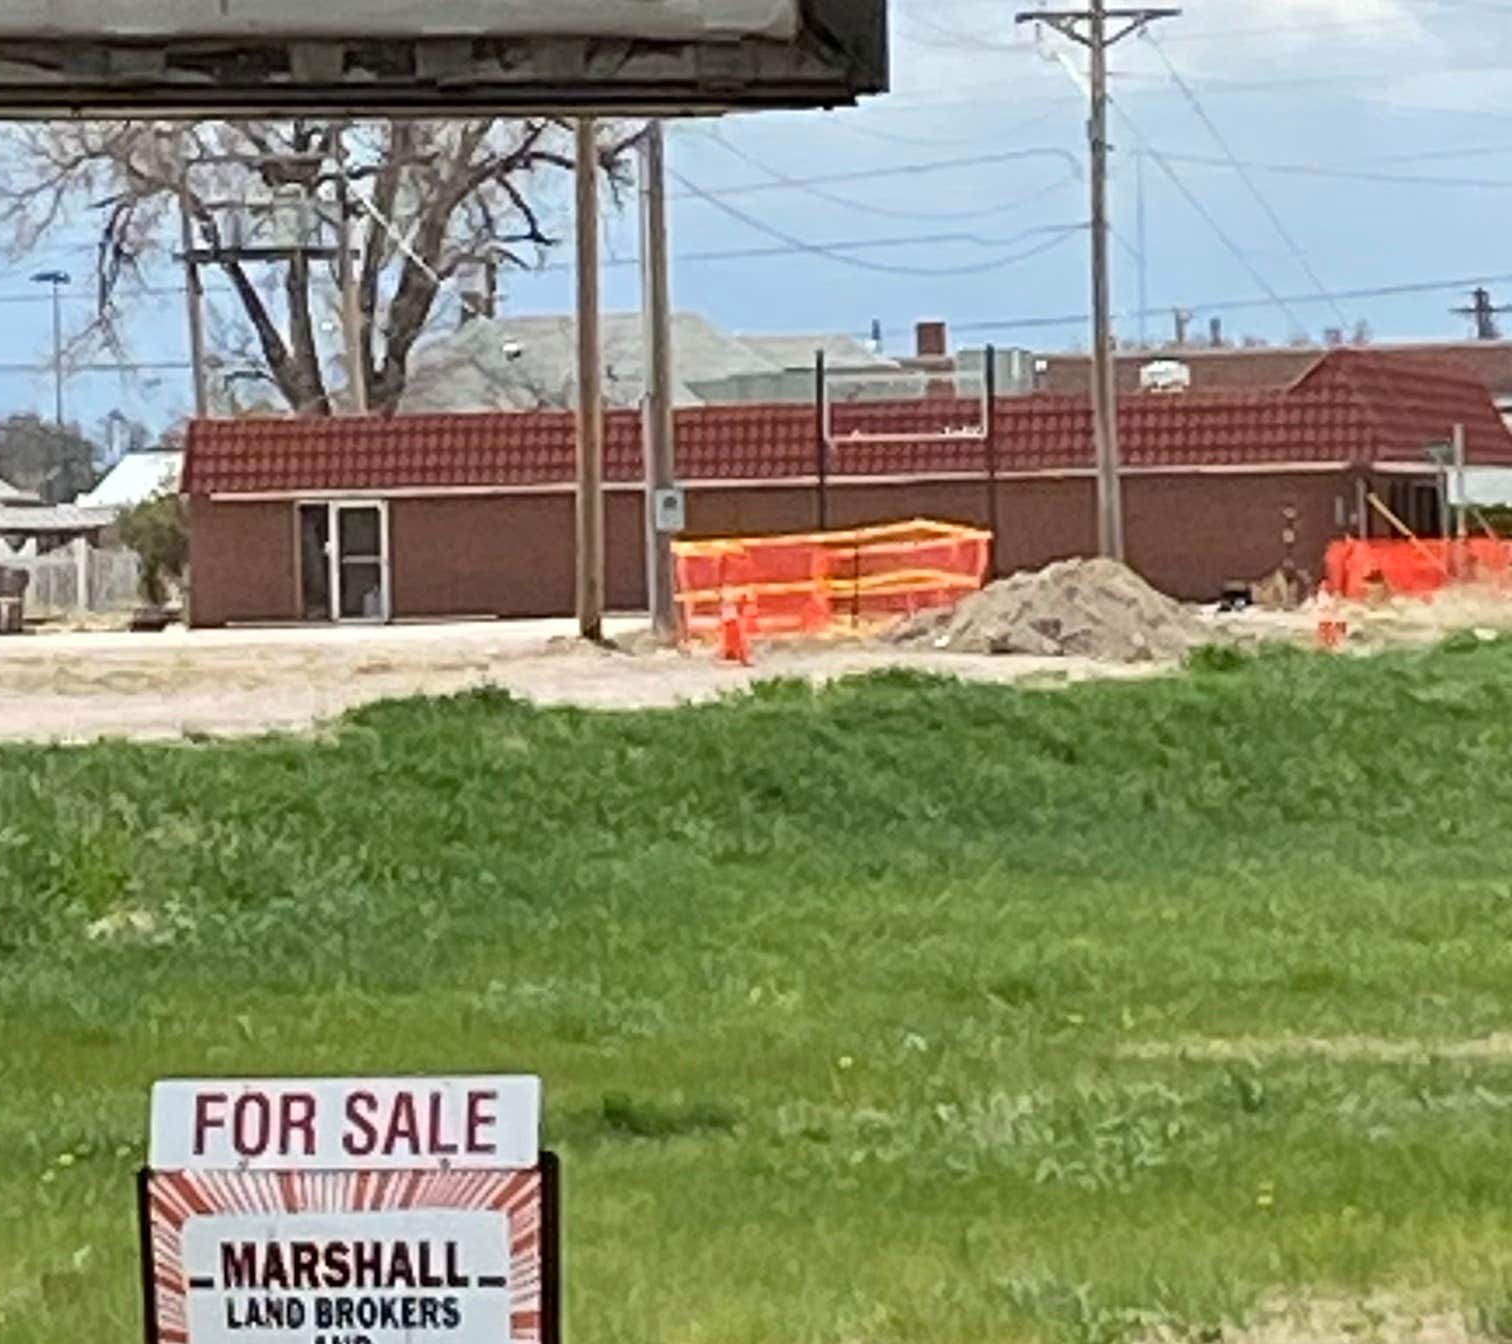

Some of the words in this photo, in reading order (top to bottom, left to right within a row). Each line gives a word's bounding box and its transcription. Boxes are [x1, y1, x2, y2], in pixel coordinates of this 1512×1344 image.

[192, 1092, 318, 1157] FOR
[342, 1090, 499, 1155] SALE
[220, 1241, 471, 1289] MARSHALL
[226, 1297, 306, 1330] LAND
[314, 1297, 462, 1330] BROKERS
